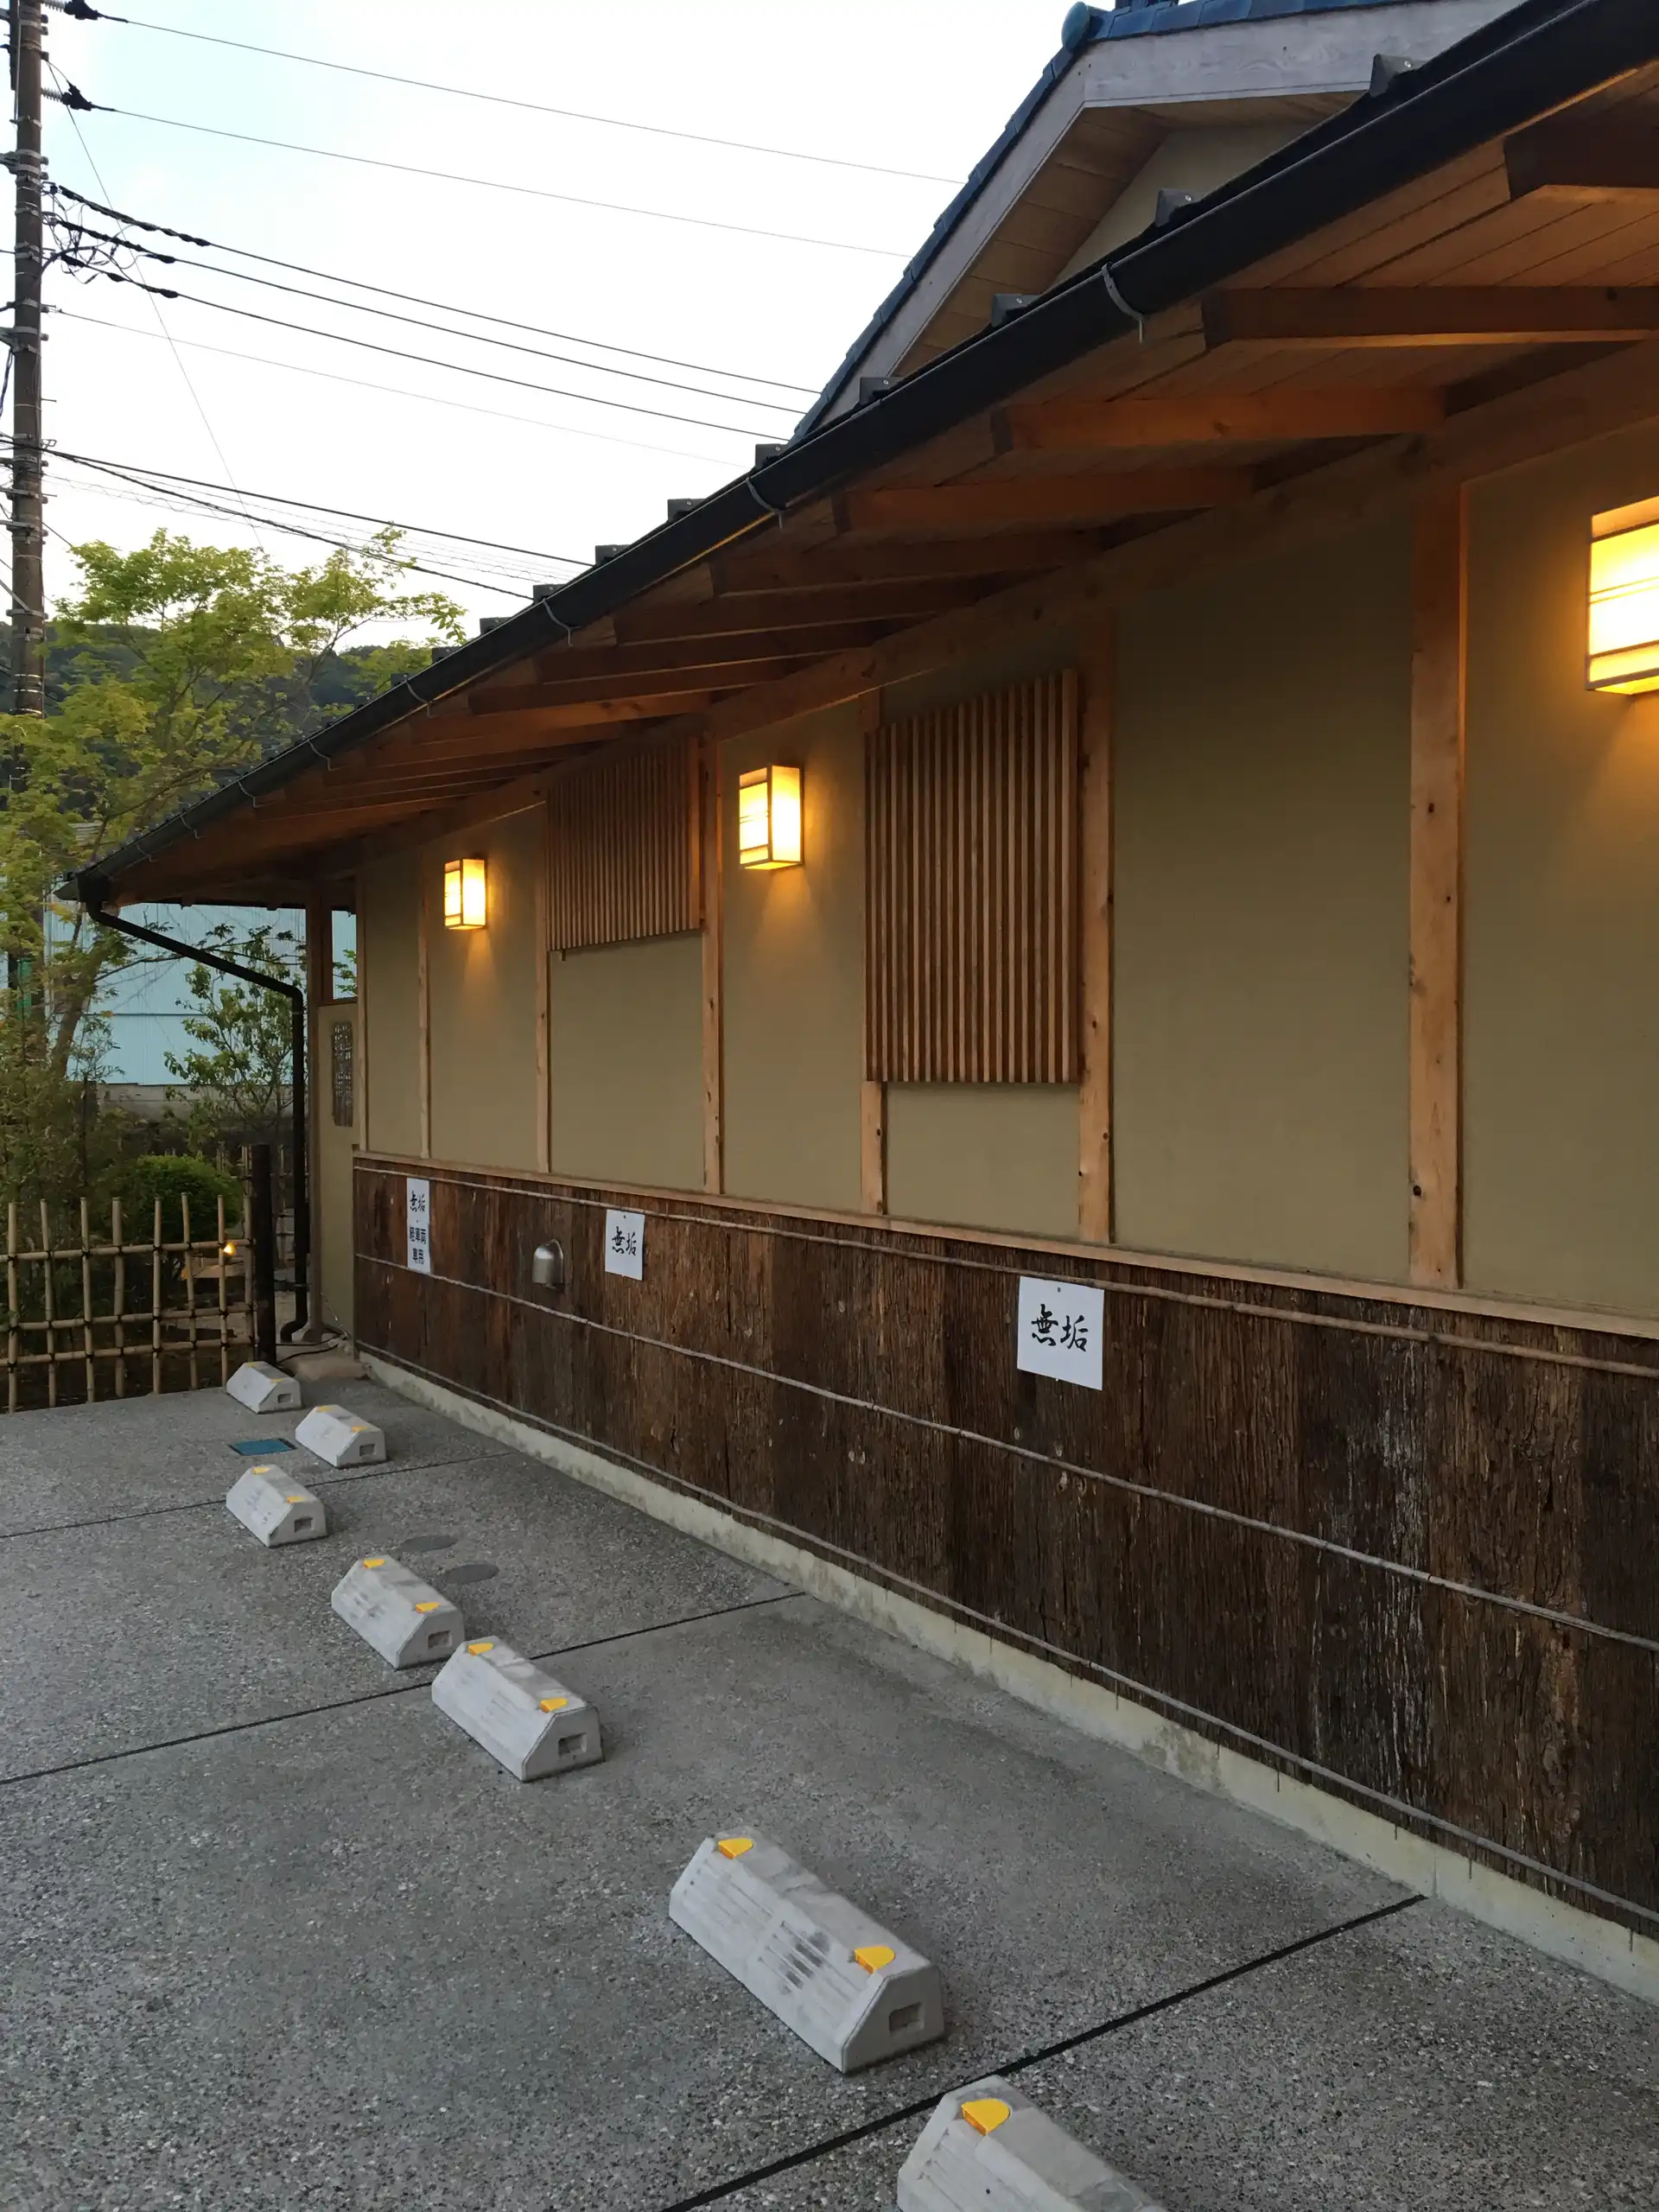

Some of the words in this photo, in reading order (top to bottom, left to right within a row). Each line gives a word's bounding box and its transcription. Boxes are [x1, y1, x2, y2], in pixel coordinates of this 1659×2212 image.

[410, 1190, 426, 1212] 無垢
[612, 1226, 637, 1256] 無垢
[1031, 1303, 1089, 1352] 無垢
